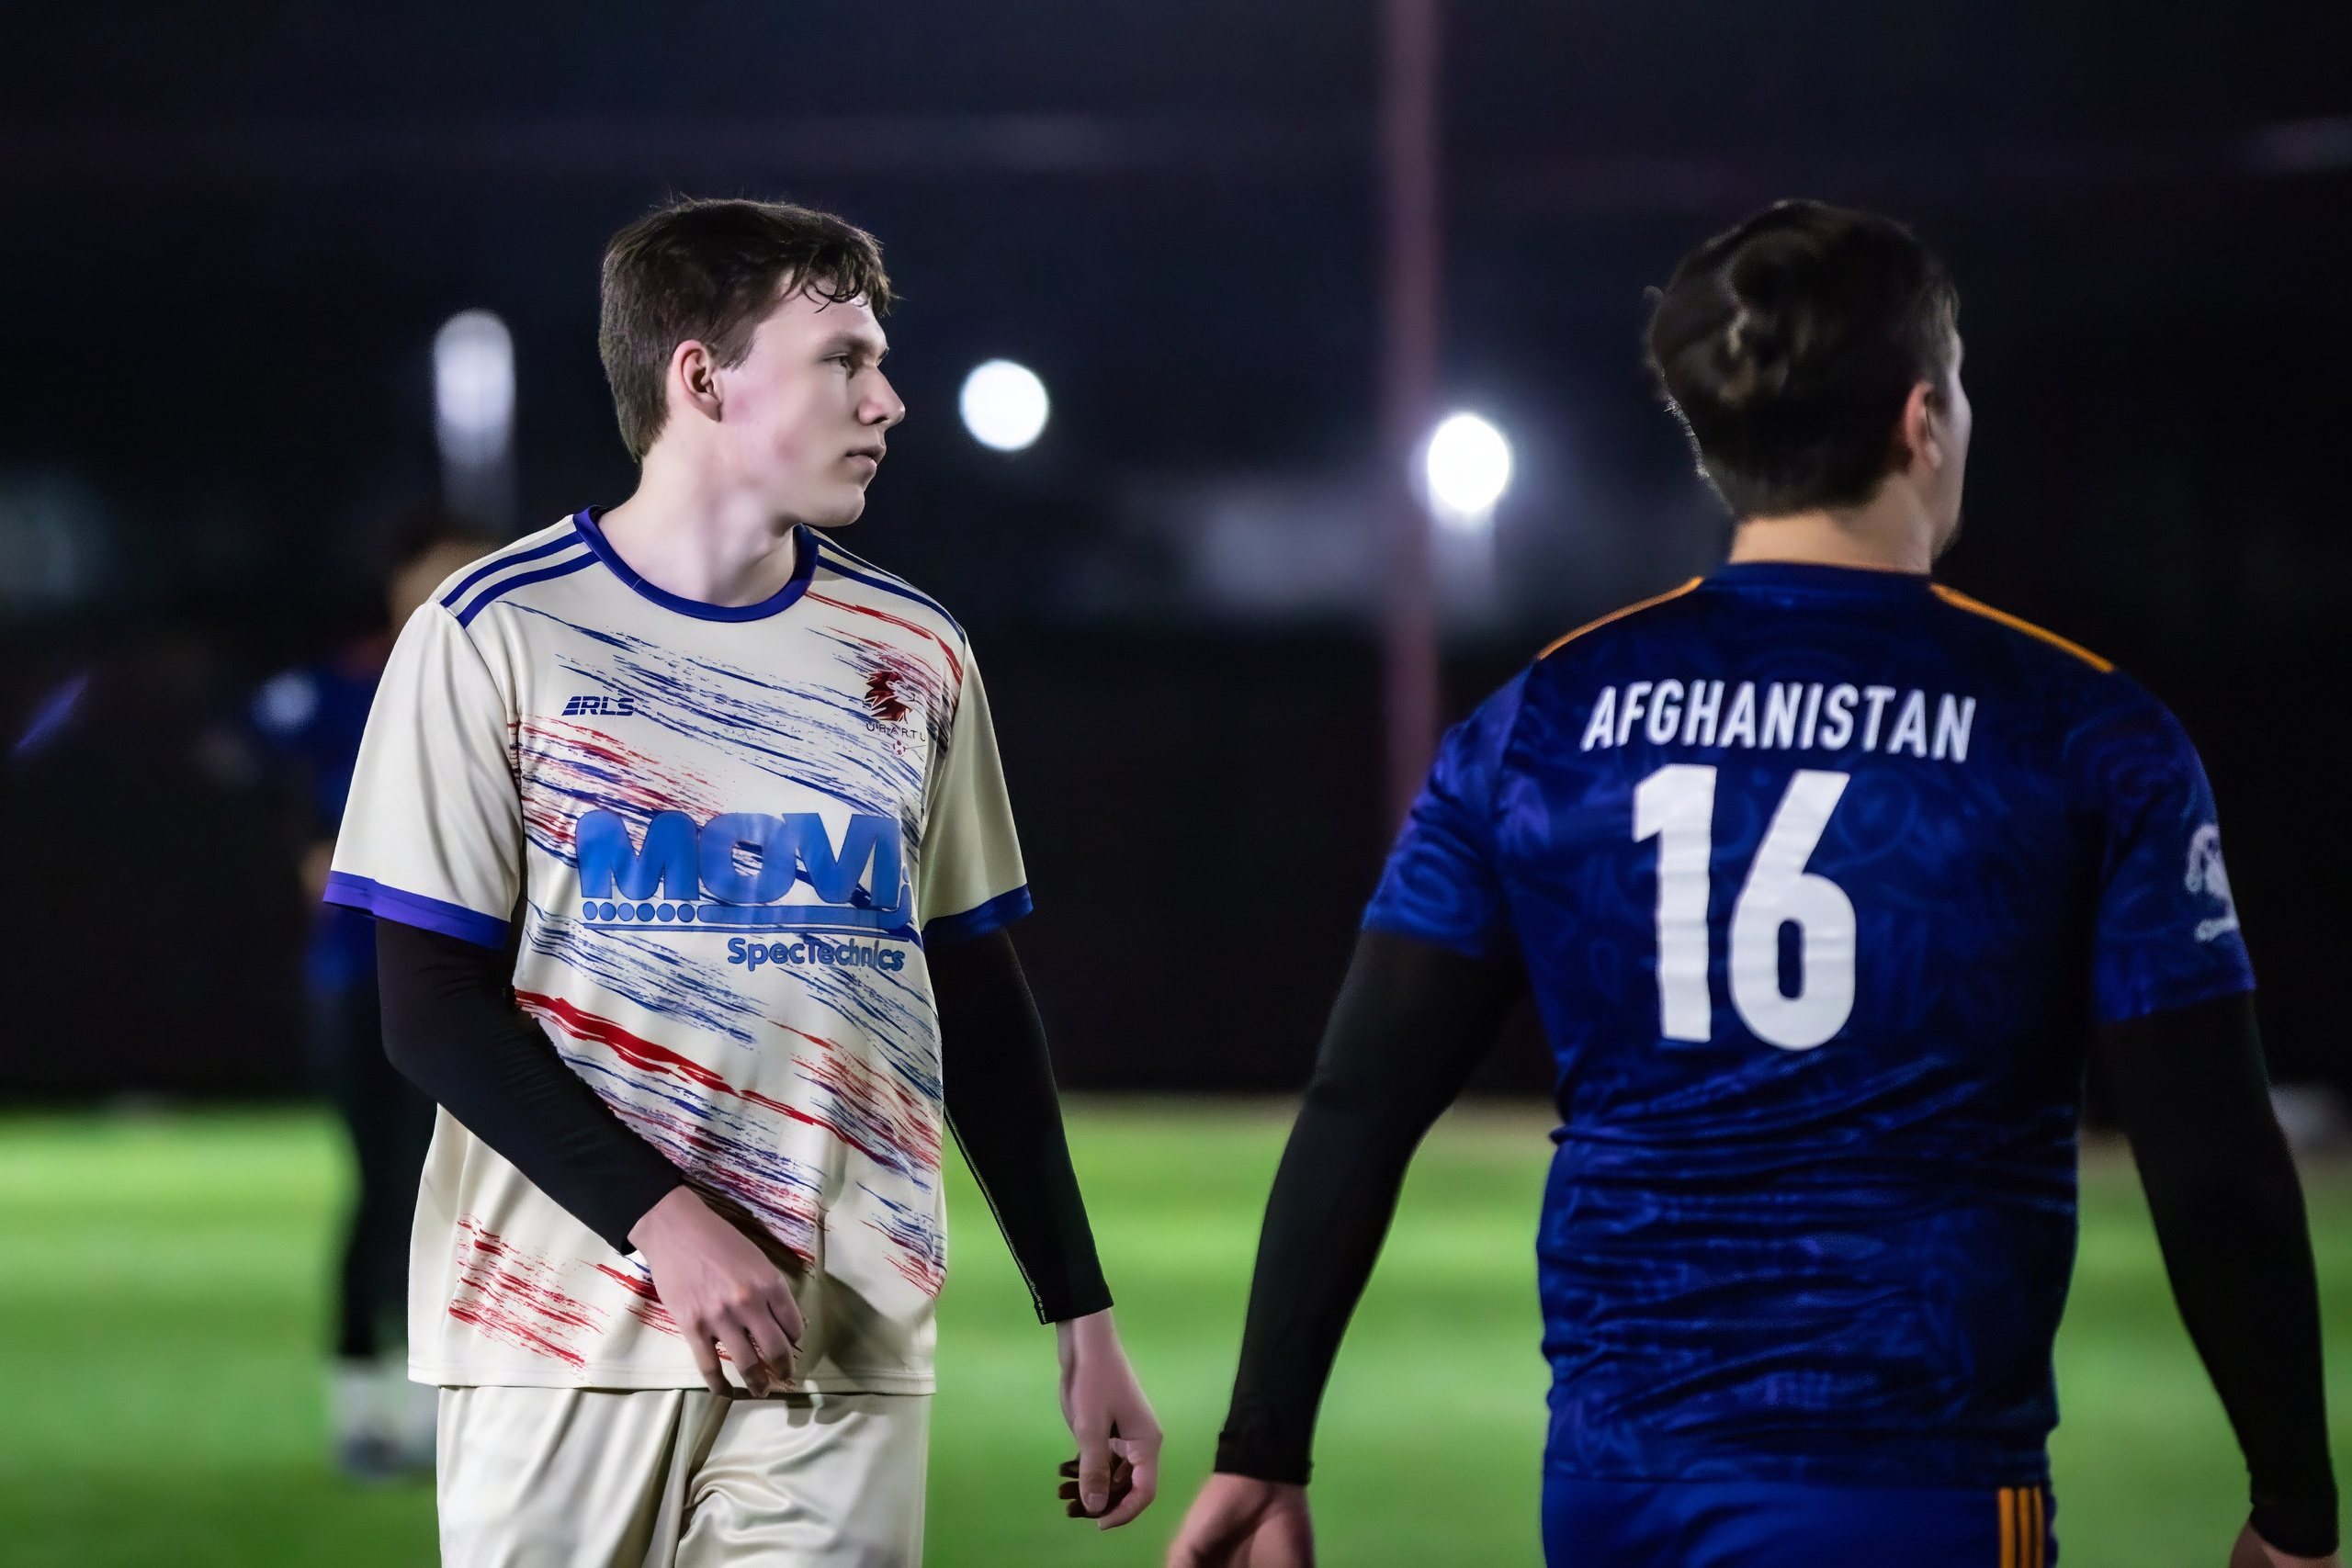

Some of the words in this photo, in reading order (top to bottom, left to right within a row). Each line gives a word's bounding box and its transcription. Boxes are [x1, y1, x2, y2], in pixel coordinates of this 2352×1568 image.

[1580, 680, 1976, 762] AFGHANISTAN
[1632, 764, 1857, 1051] 16
[727, 937, 906, 971] SpecTechnics
